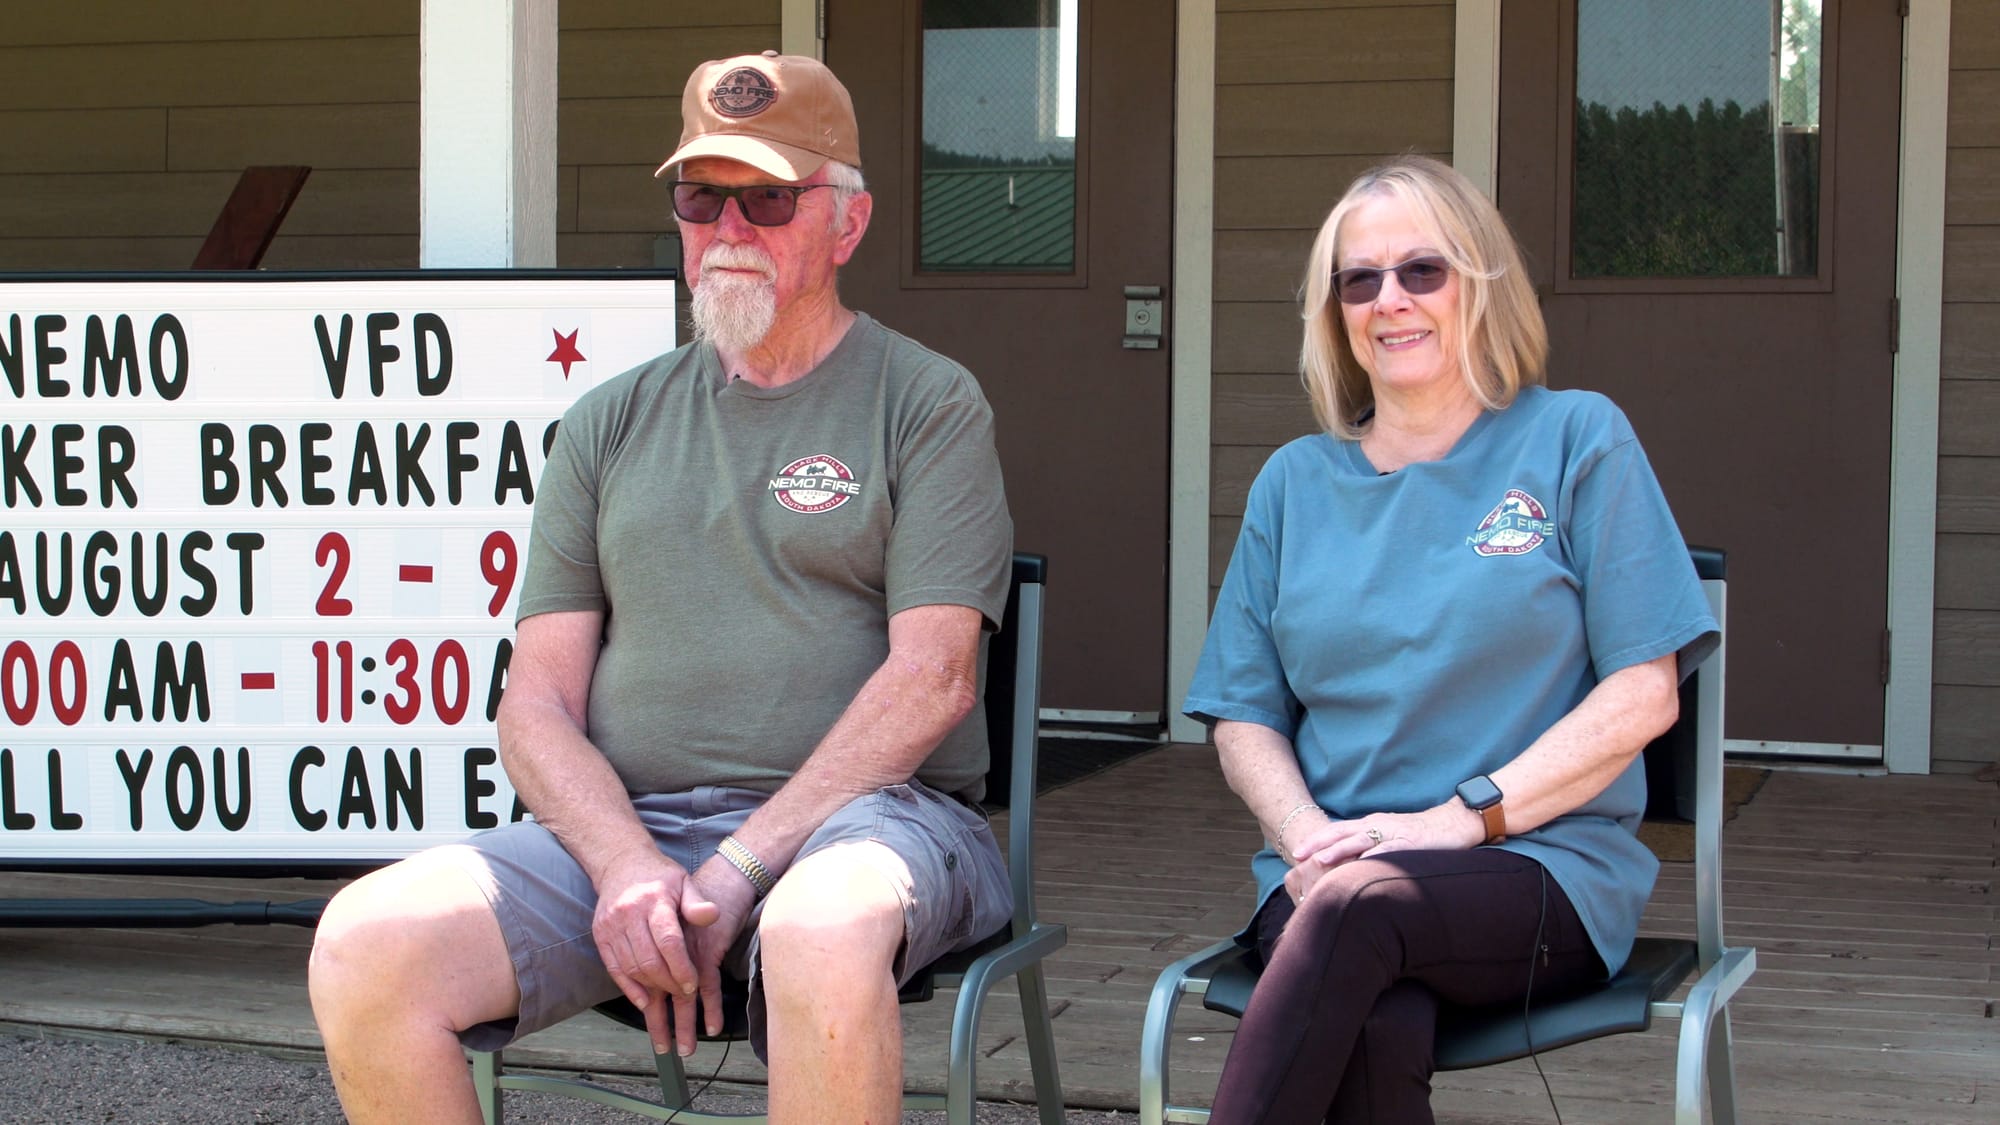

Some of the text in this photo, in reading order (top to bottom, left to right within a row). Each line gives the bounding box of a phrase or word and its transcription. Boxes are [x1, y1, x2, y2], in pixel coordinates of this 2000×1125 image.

[0, 312, 453, 400] NEMO VFD
[201, 420, 561, 508] BREAKFA
[768, 477, 861, 495] NEMO FIRE
[822, 457, 845, 474] HILLS
[781, 493, 842, 512] SOUTH DAKOTA
[1465, 516, 1555, 546] NEMO FIRE
[0, 530, 265, 617] AUGUST
[315, 531, 353, 617] 2
[480, 530, 518, 617] 9
[116, 746, 251, 832] YOU
[289, 745, 424, 831] CAN
[463, 747, 536, 830] E
